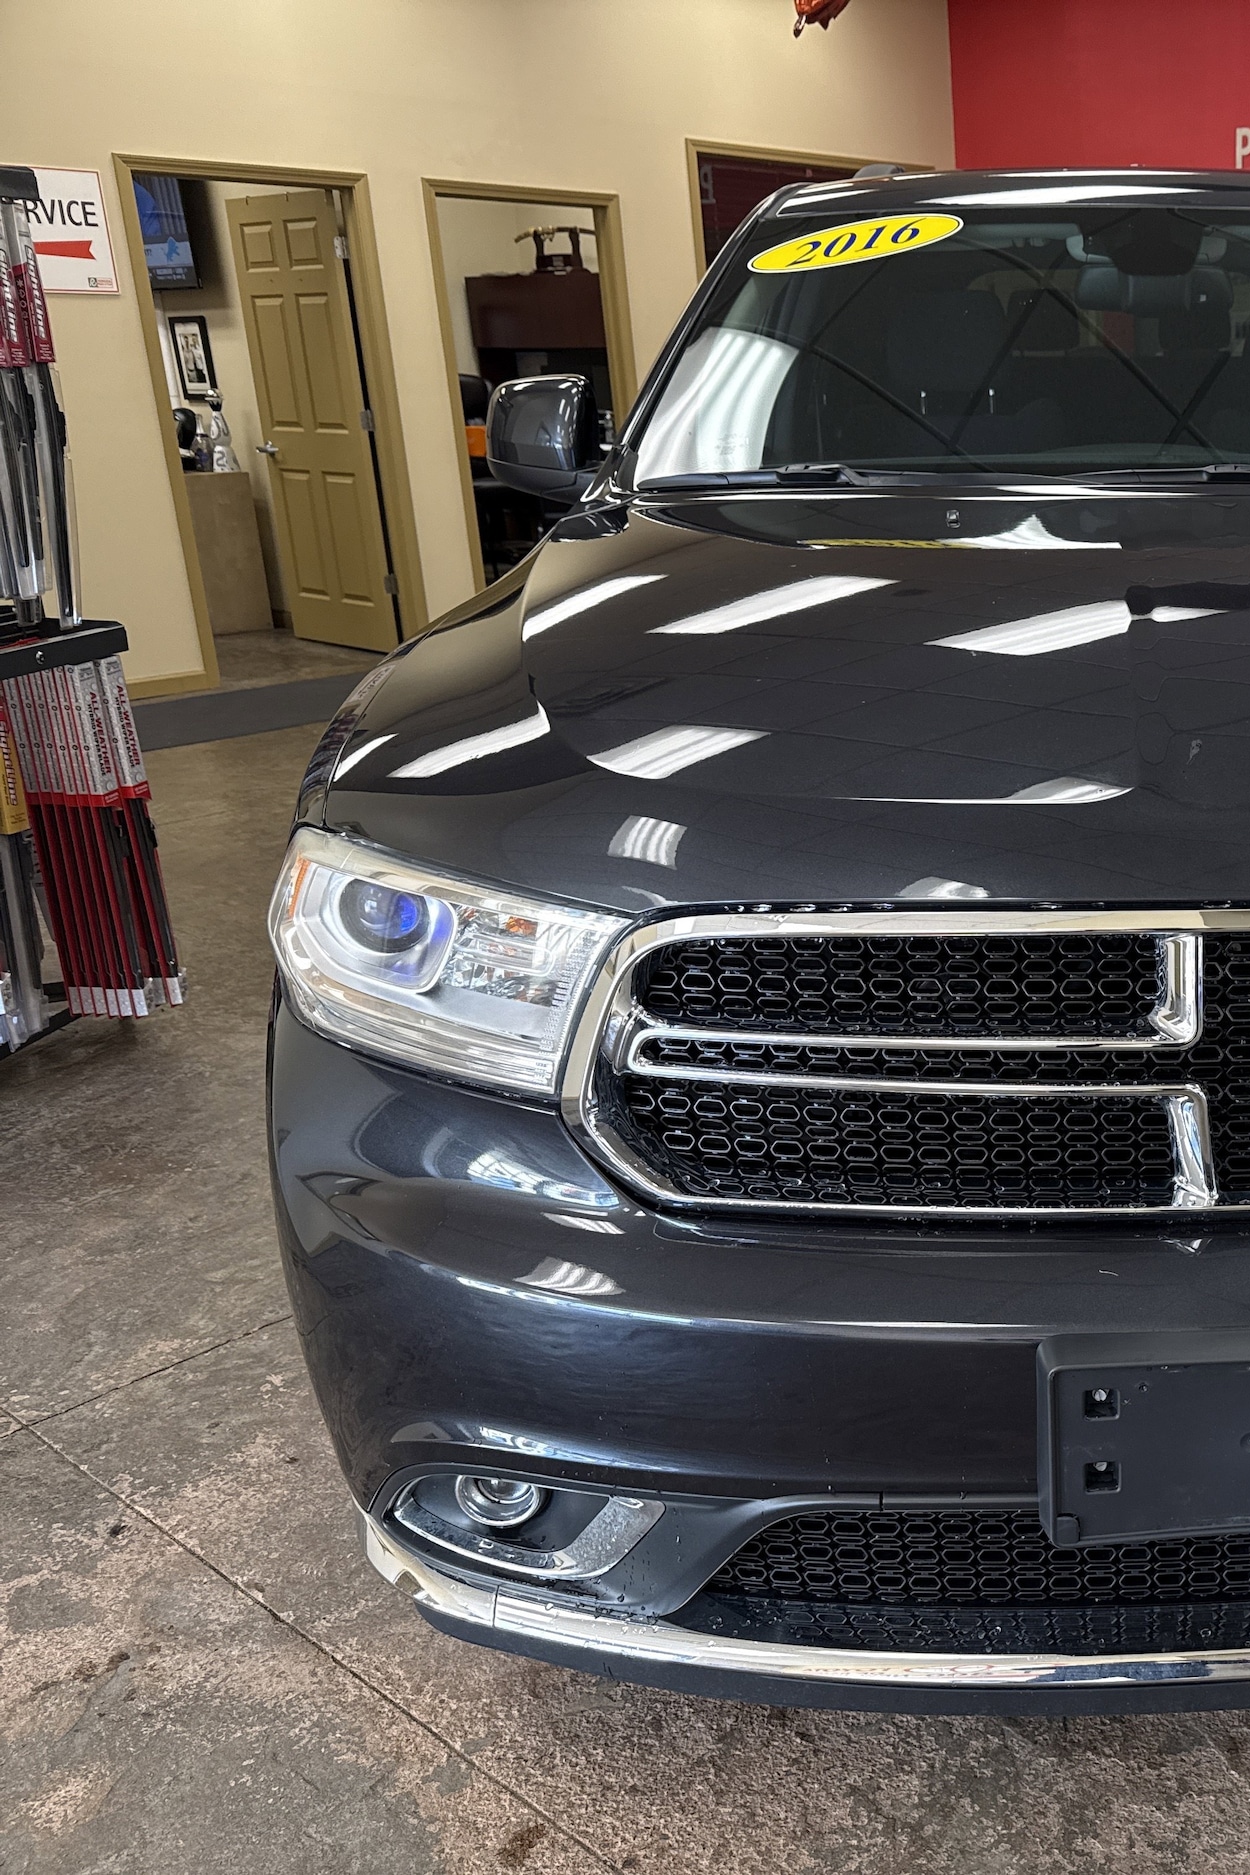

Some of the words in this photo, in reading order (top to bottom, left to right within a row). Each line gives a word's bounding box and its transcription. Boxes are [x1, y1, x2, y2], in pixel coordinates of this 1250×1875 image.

[23, 199, 98, 227] RVICE
[785, 217, 927, 267] 2016
[25, 245, 46, 339] SightLine
[90, 692, 112, 773] ALL-WEATHER
[117, 686, 140, 765] ALL-WEATHER
